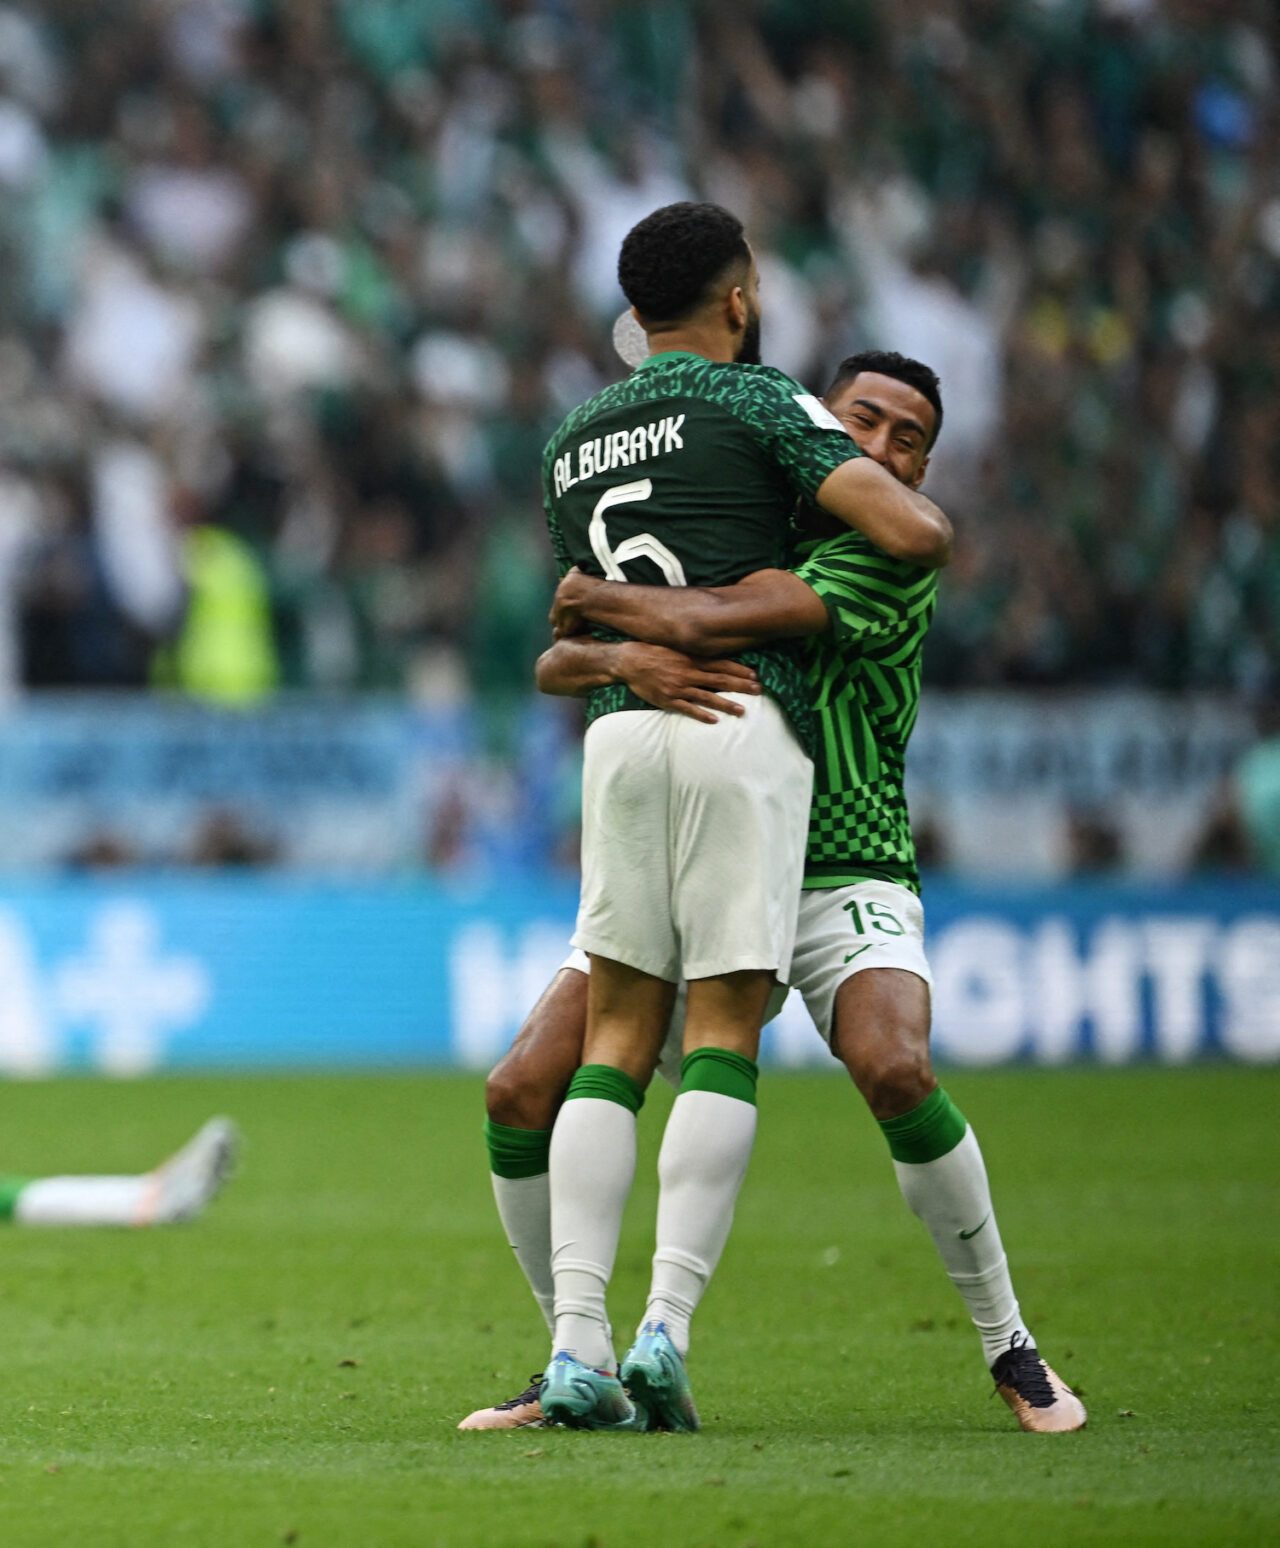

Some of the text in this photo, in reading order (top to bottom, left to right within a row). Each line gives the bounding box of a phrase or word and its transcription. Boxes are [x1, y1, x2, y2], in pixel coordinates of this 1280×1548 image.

[554, 414, 686, 498] ALBURAYK
[588, 478, 687, 587] 6
[842, 900, 906, 936] 15
